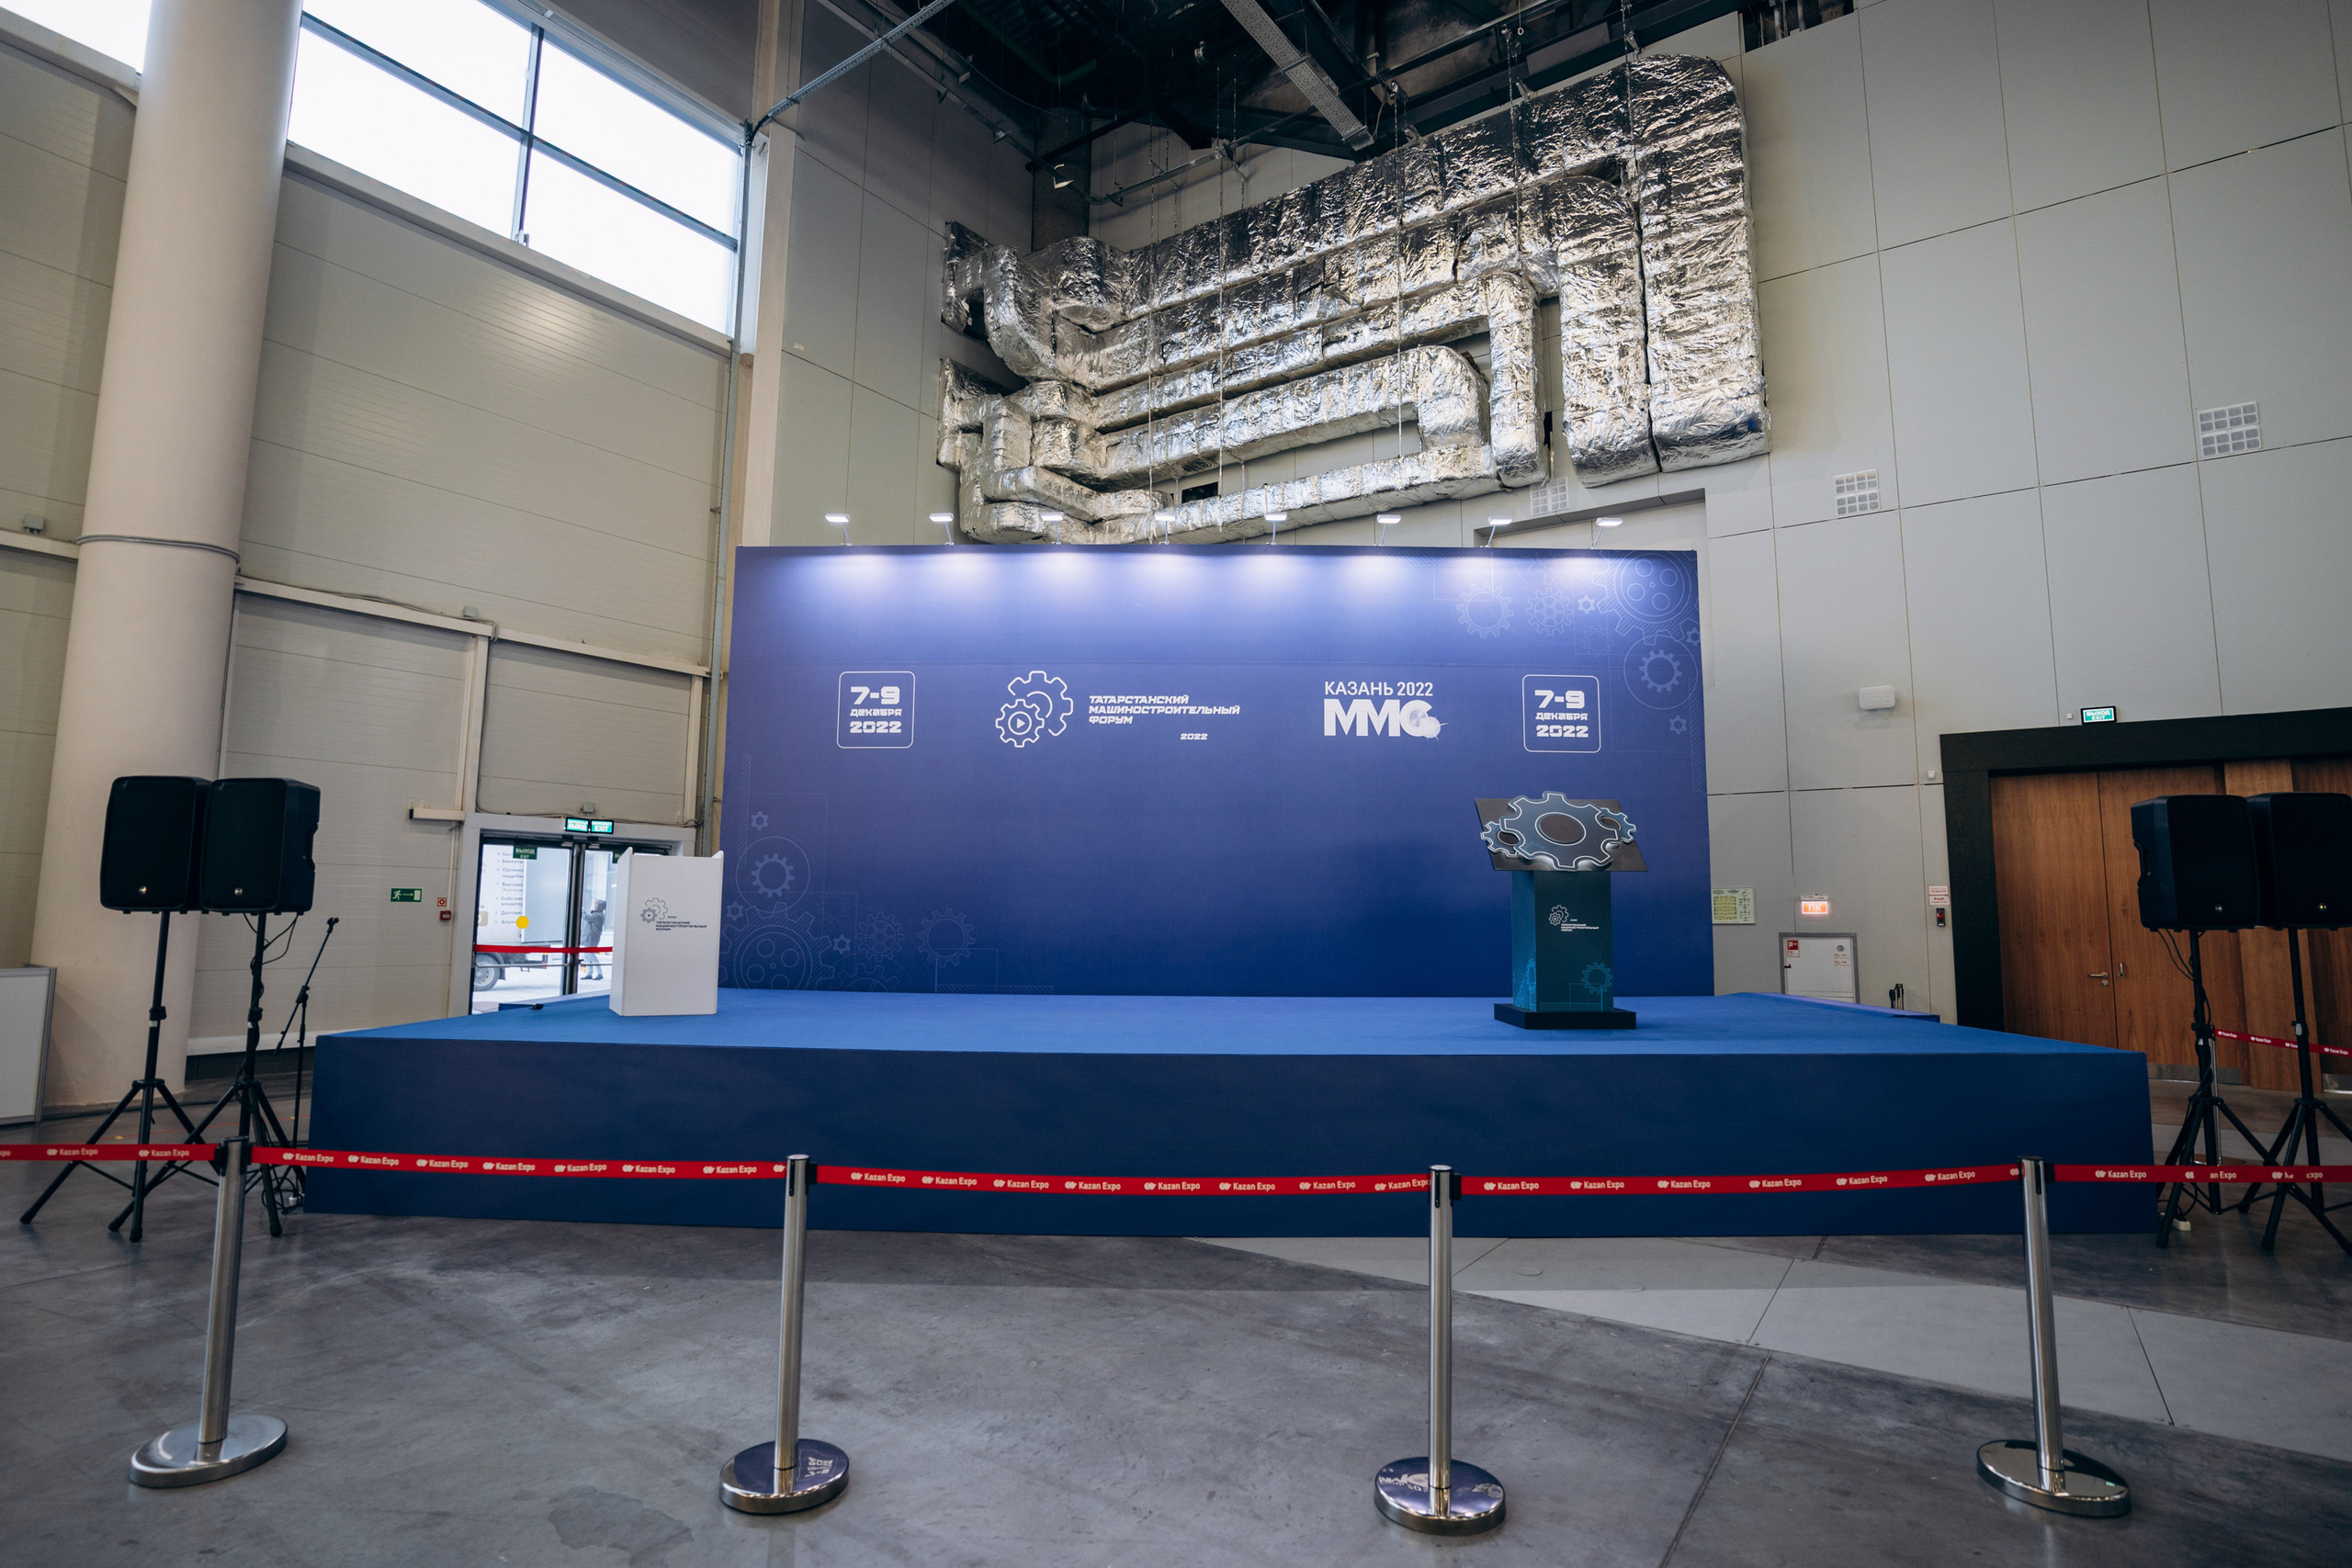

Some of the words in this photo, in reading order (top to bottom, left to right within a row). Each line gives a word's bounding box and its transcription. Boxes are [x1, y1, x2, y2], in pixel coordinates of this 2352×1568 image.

[1325, 682, 1394, 696] КАЗАНЬ
[1396, 682, 1433, 696] 2022
[850, 686, 900, 705] 7-9
[1089, 694, 1189, 705] ТАТАРСТАНСКИЙ
[1534, 690, 1585, 709] 7-9
[1089, 705, 1240, 715] МАШИНОСТРОИТЕЛЬНЫЙ
[1089, 716, 1133, 725] ФОРУМ
[850, 721, 901, 734] 2022
[1536, 724, 1589, 738] 2022
[317, 1155, 334, 1163] Expo
[382, 1157, 399, 1167] Expo
[451, 1160, 468, 1168] Expo
[518, 1163, 535, 1172] Expo
[589, 1164, 606, 1172] Expo
[658, 1166, 675, 1175] Expo
[739, 1166, 756, 1174] Expo
[2130, 1170, 2146, 1179] Expo
[888, 1174, 905, 1183] Expo
[1959, 1171, 1975, 1179] Expo
[2220, 1171, 2236, 1179] Expo
[959, 1178, 977, 1187] Expo
[1693, 1180, 1711, 1189] Expo
[1784, 1179, 1802, 1187] Expo
[1871, 1176, 1887, 1184] Expo
[1031, 1180, 1049, 1190] Expo
[1102, 1182, 1121, 1191] Expo
[1182, 1182, 1200, 1190] Expo
[1257, 1182, 1275, 1191] Expo
[1337, 1181, 1355, 1190] Expo
[1521, 1181, 1539, 1190] Expo
[1607, 1180, 1624, 1190] Expo
